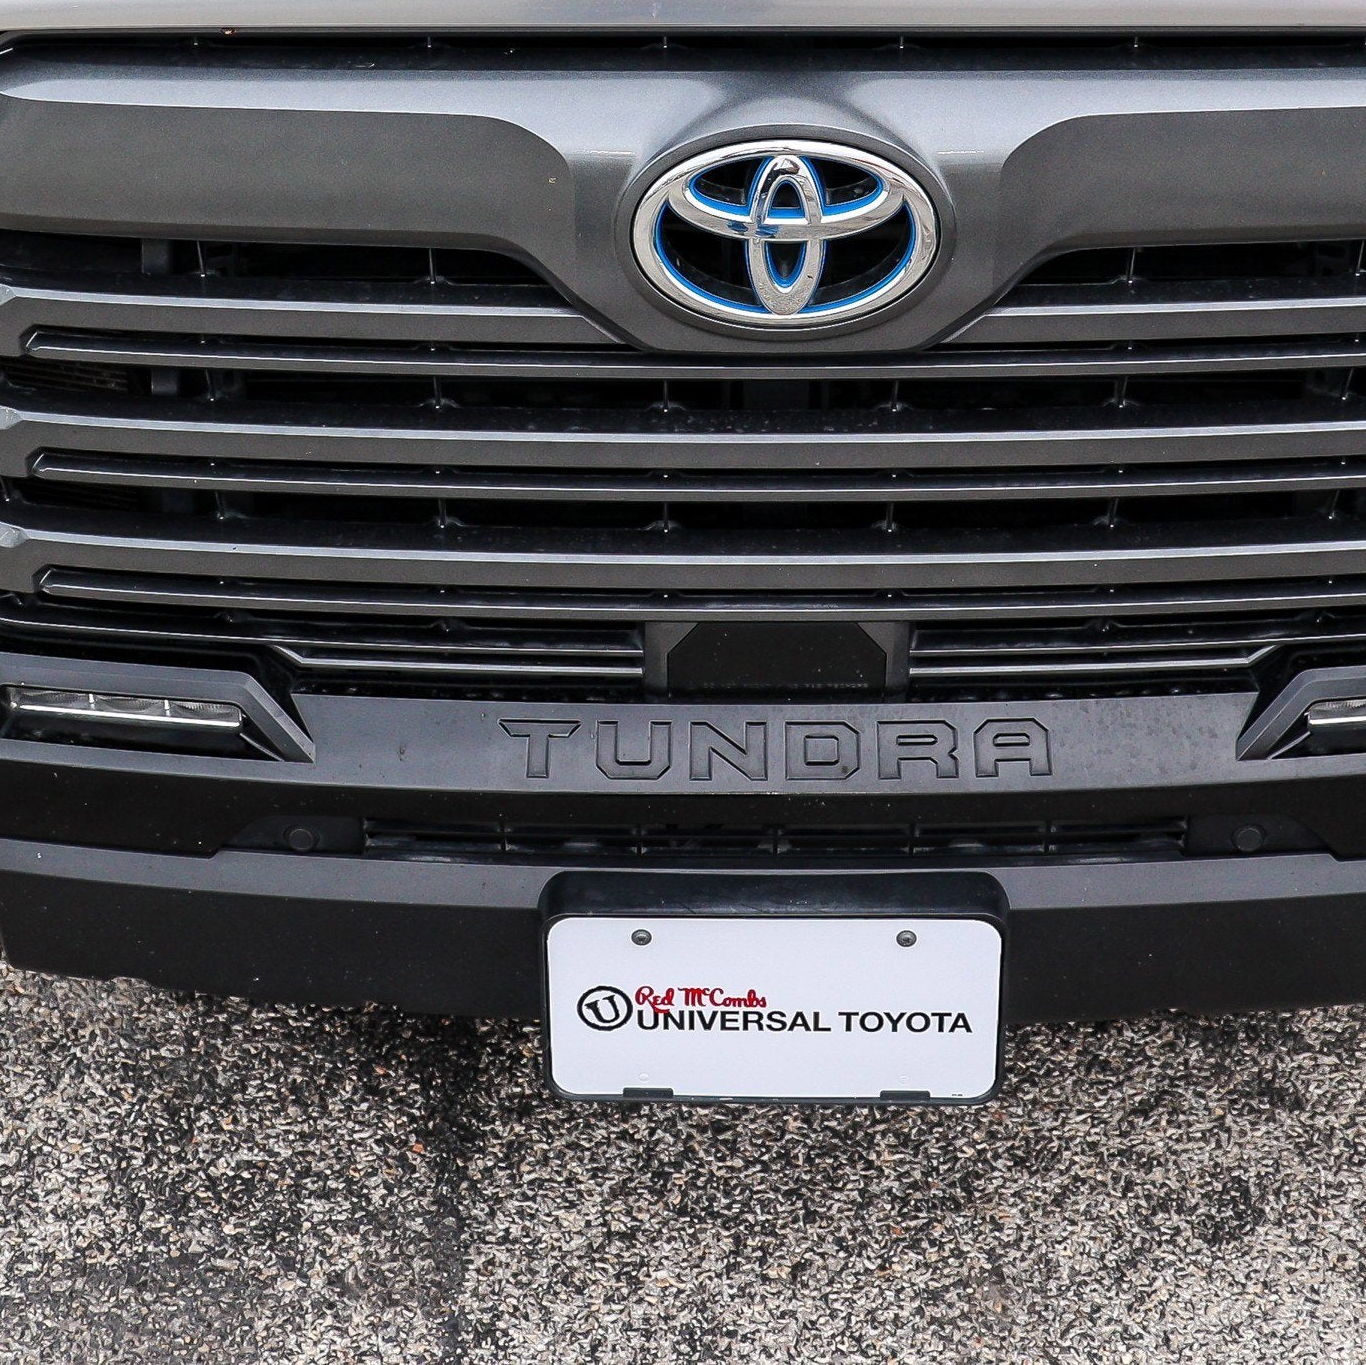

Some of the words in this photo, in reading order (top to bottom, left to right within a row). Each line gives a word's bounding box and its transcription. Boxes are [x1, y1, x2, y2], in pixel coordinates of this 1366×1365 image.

[497, 717, 1053, 782] TUNDRA
[635, 985, 675, 1013] Red
[678, 987, 768, 1009] McCombs
[636, 1010, 832, 1032] UNIVERSAL
[838, 1011, 973, 1034] TOYOTA
